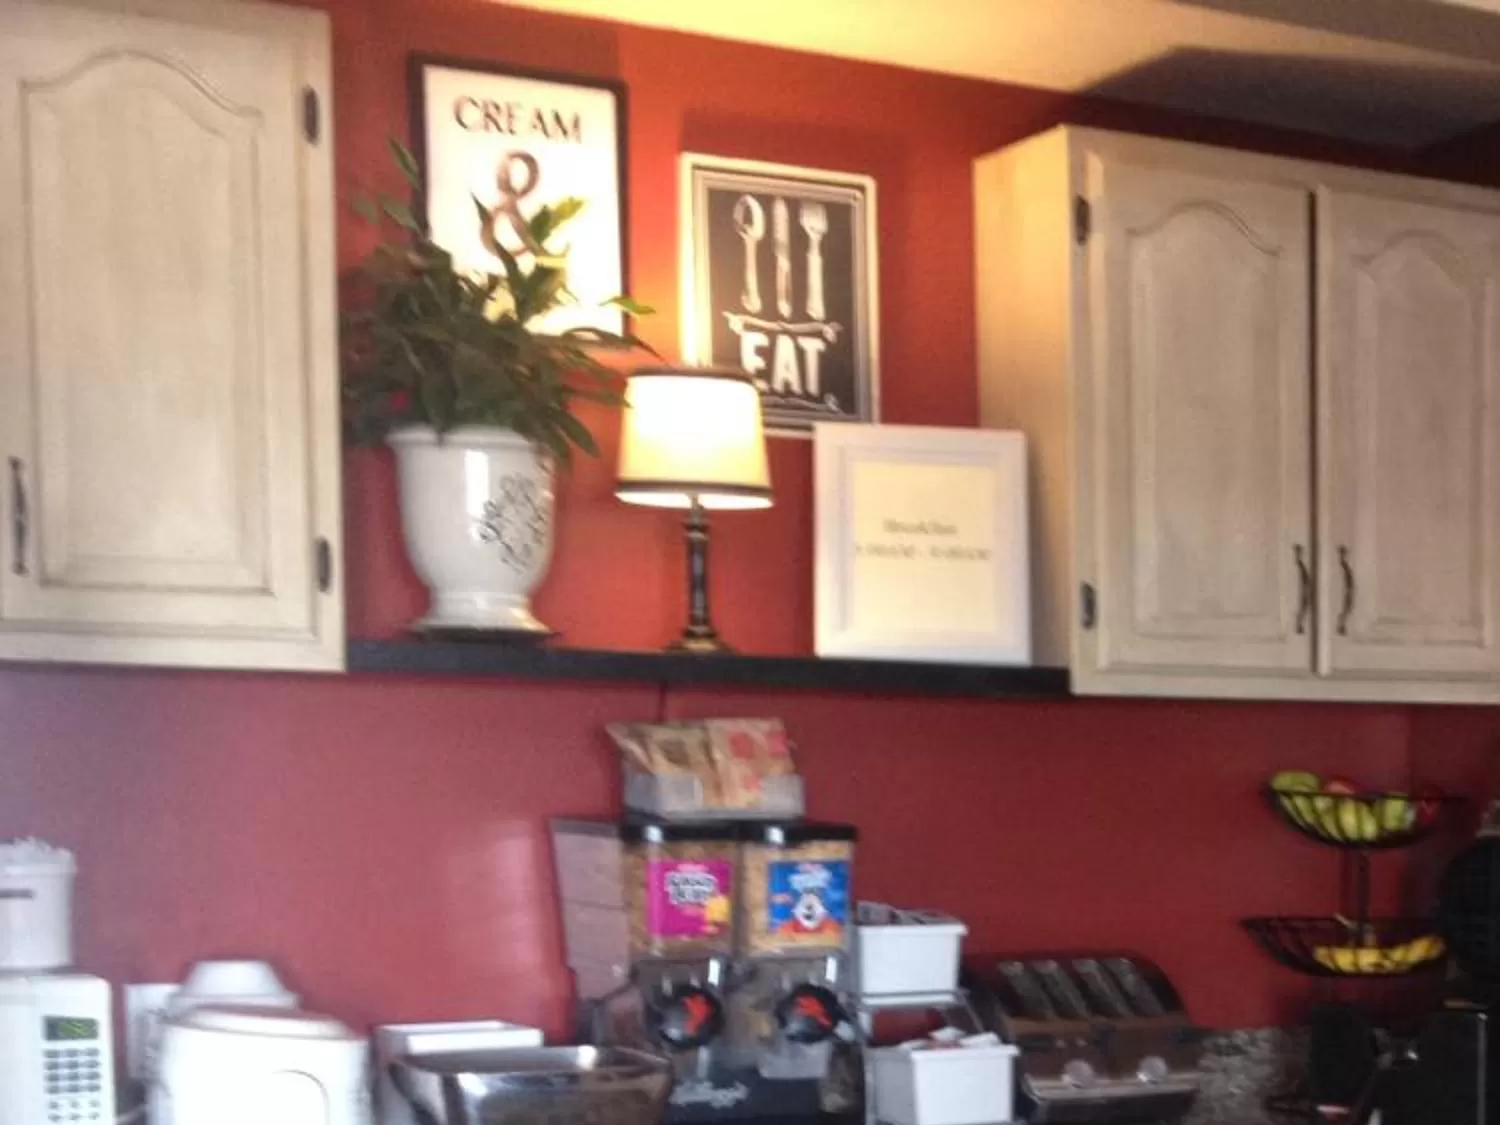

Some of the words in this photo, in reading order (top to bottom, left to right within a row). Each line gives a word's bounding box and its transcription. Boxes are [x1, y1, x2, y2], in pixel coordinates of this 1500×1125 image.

[453, 95, 583, 144] CREAM
[480, 150, 571, 262] &
[740, 331, 826, 398] EAT
